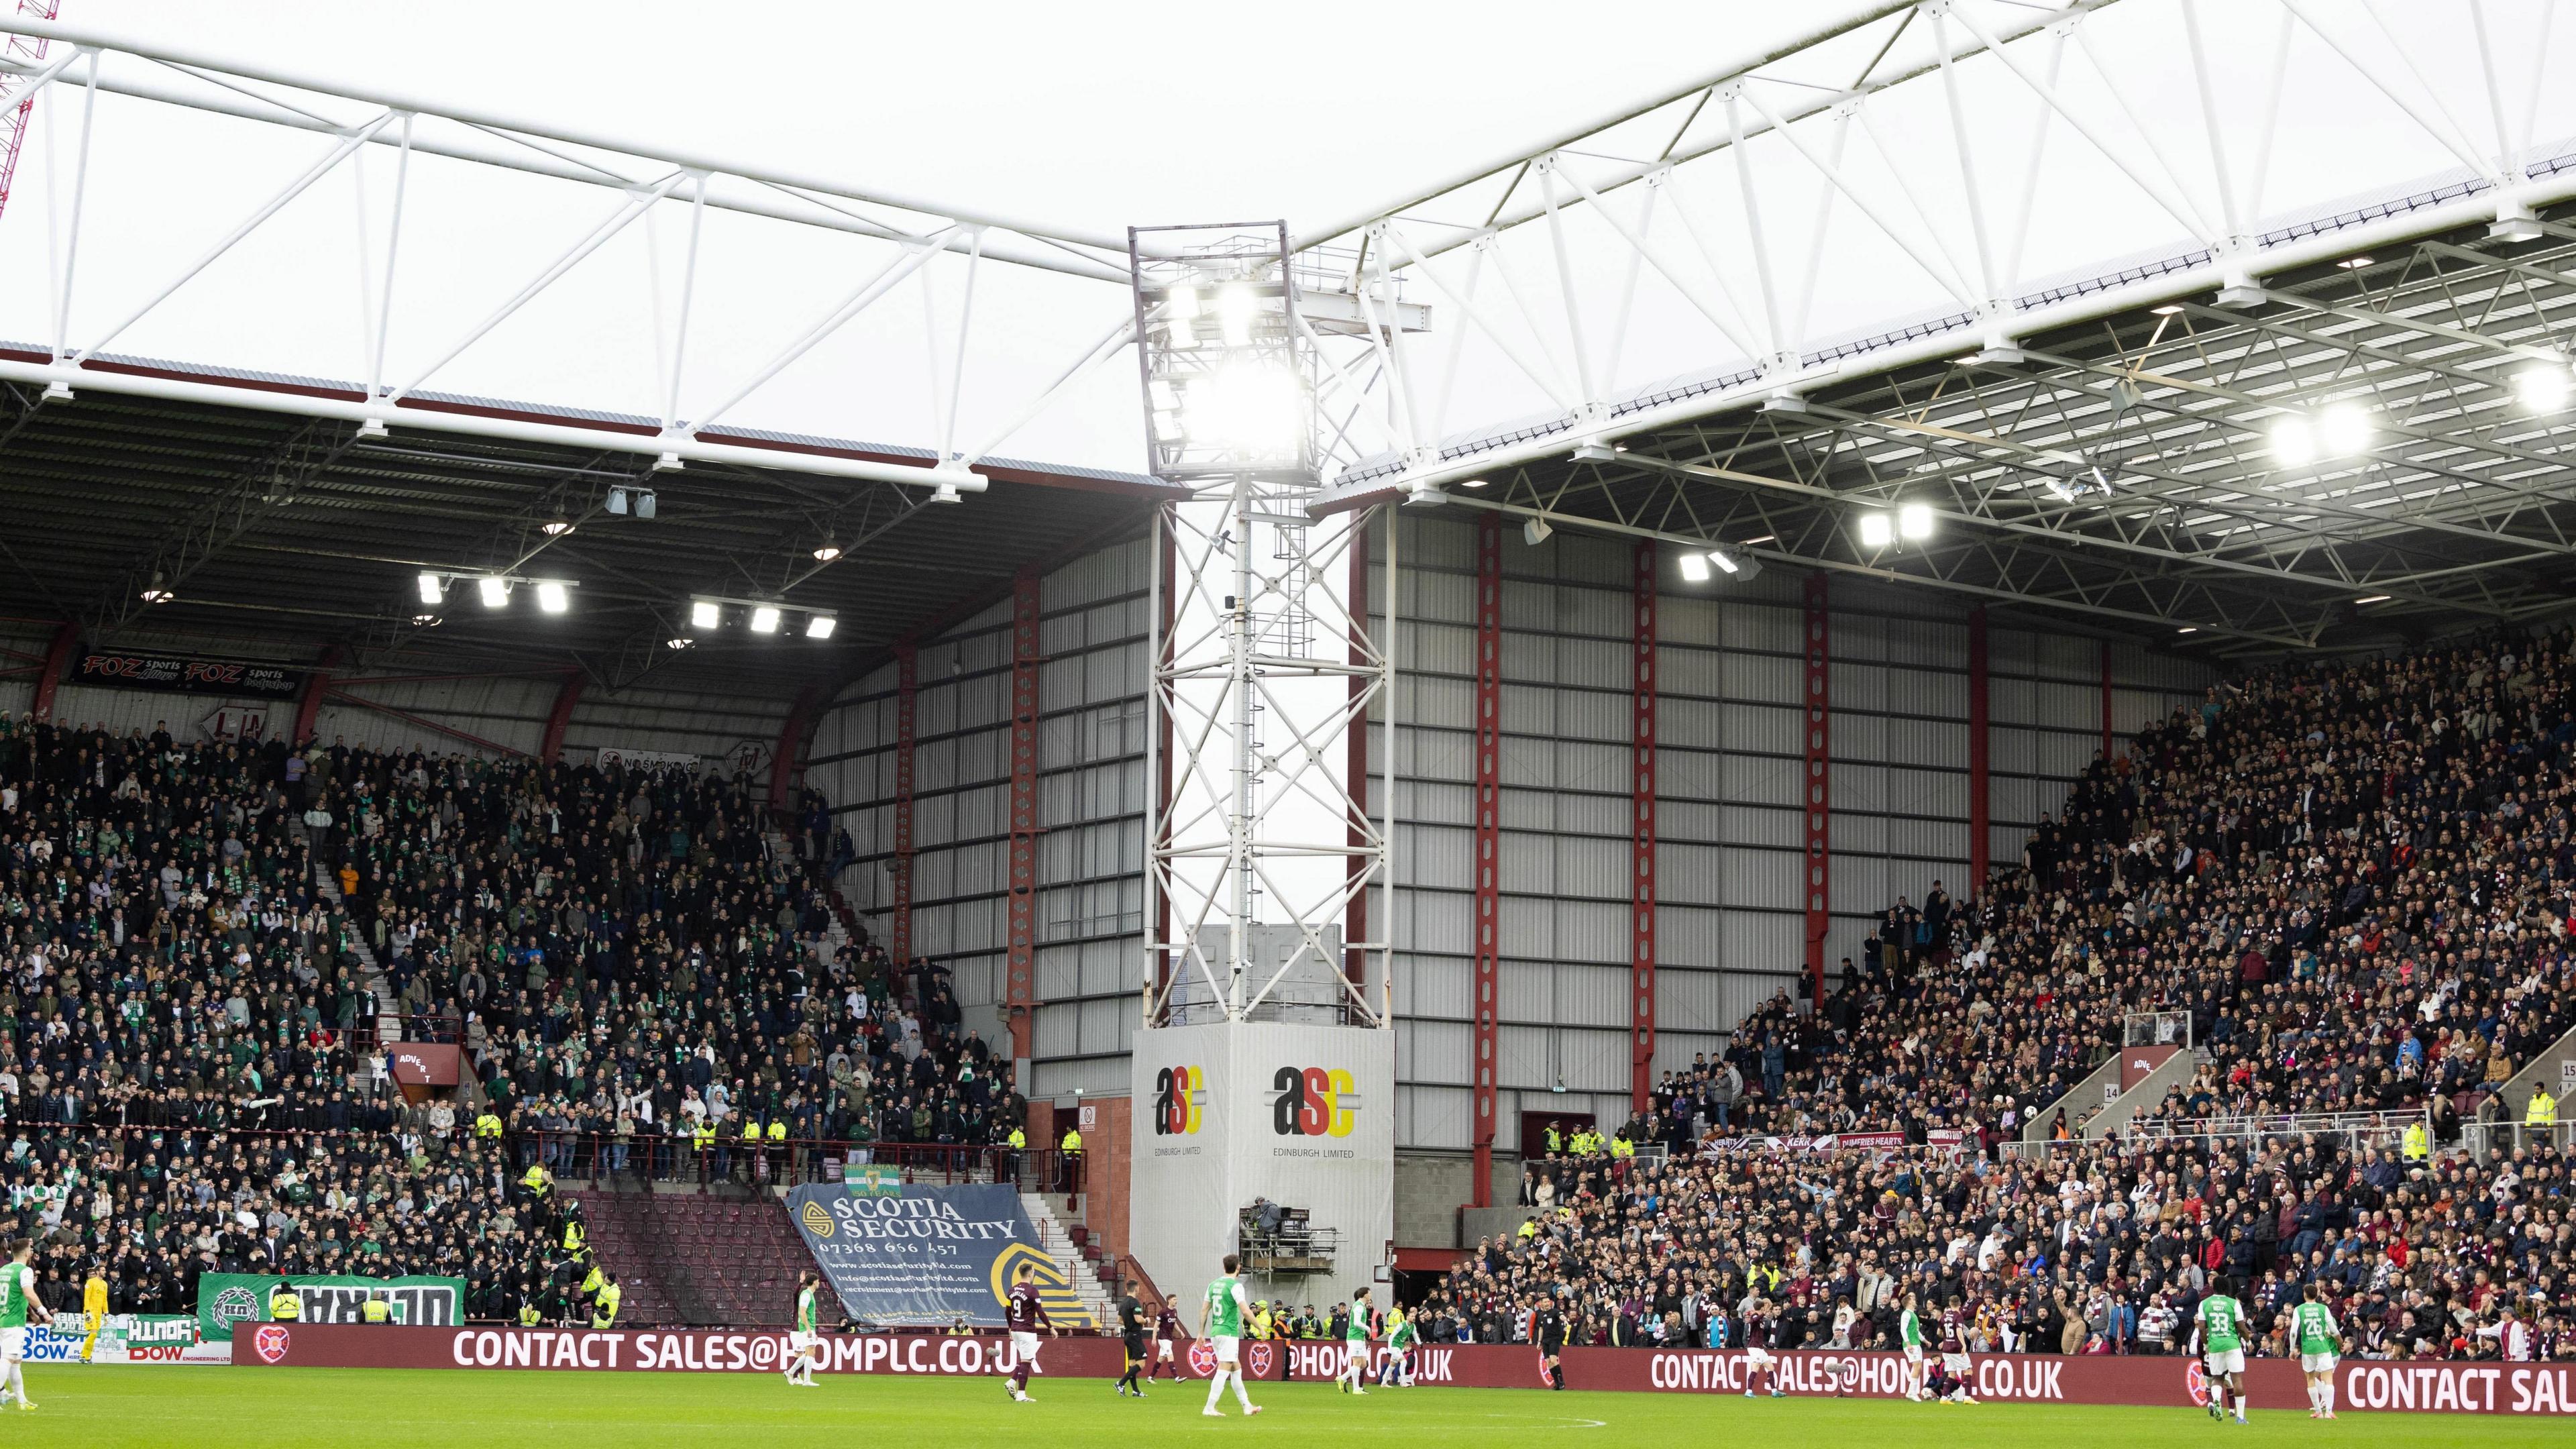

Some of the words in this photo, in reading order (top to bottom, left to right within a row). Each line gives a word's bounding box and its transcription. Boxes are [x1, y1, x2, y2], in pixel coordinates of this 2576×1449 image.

[83, 655, 145, 678] FOZ
[146, 660, 181, 670] sports
[184, 662, 245, 683] FOZ
[250, 669, 284, 679] sports
[2564, 1065, 2575, 1076] 15
[2106, 1088, 2118, 1098] 14
[1786, 1138, 1811, 1146] KERR
[1842, 1138, 1874, 1146] DUMFRIES
[1875, 1137, 1902, 1146] HEARTS
[1155, 1147, 1181, 1157] EDINBURGH
[1182, 1146, 1201, 1156] LIMITED
[1273, 1148, 1320, 1158] EDINBURGH
[1323, 1150, 1354, 1159] LIMITED
[833, 1197, 965, 1221] SCOTIA
[841, 1218, 1018, 1240] SECURITY
[819, 1242, 877, 1254] 07368
[1013, 1299, 1021, 1318] 9
[1212, 1295, 1223, 1316] 15
[128, 1319, 193, 1342] YOUTH
[1943, 1322, 1955, 1338] 16
[2209, 1312, 2229, 1332] 33
[2304, 1318, 2323, 1336] 26
[453, 1331, 625, 1367] CONTACT
[1651, 1354, 1760, 1391] CONTACT
[2348, 1367, 2501, 1411] CONTACT
